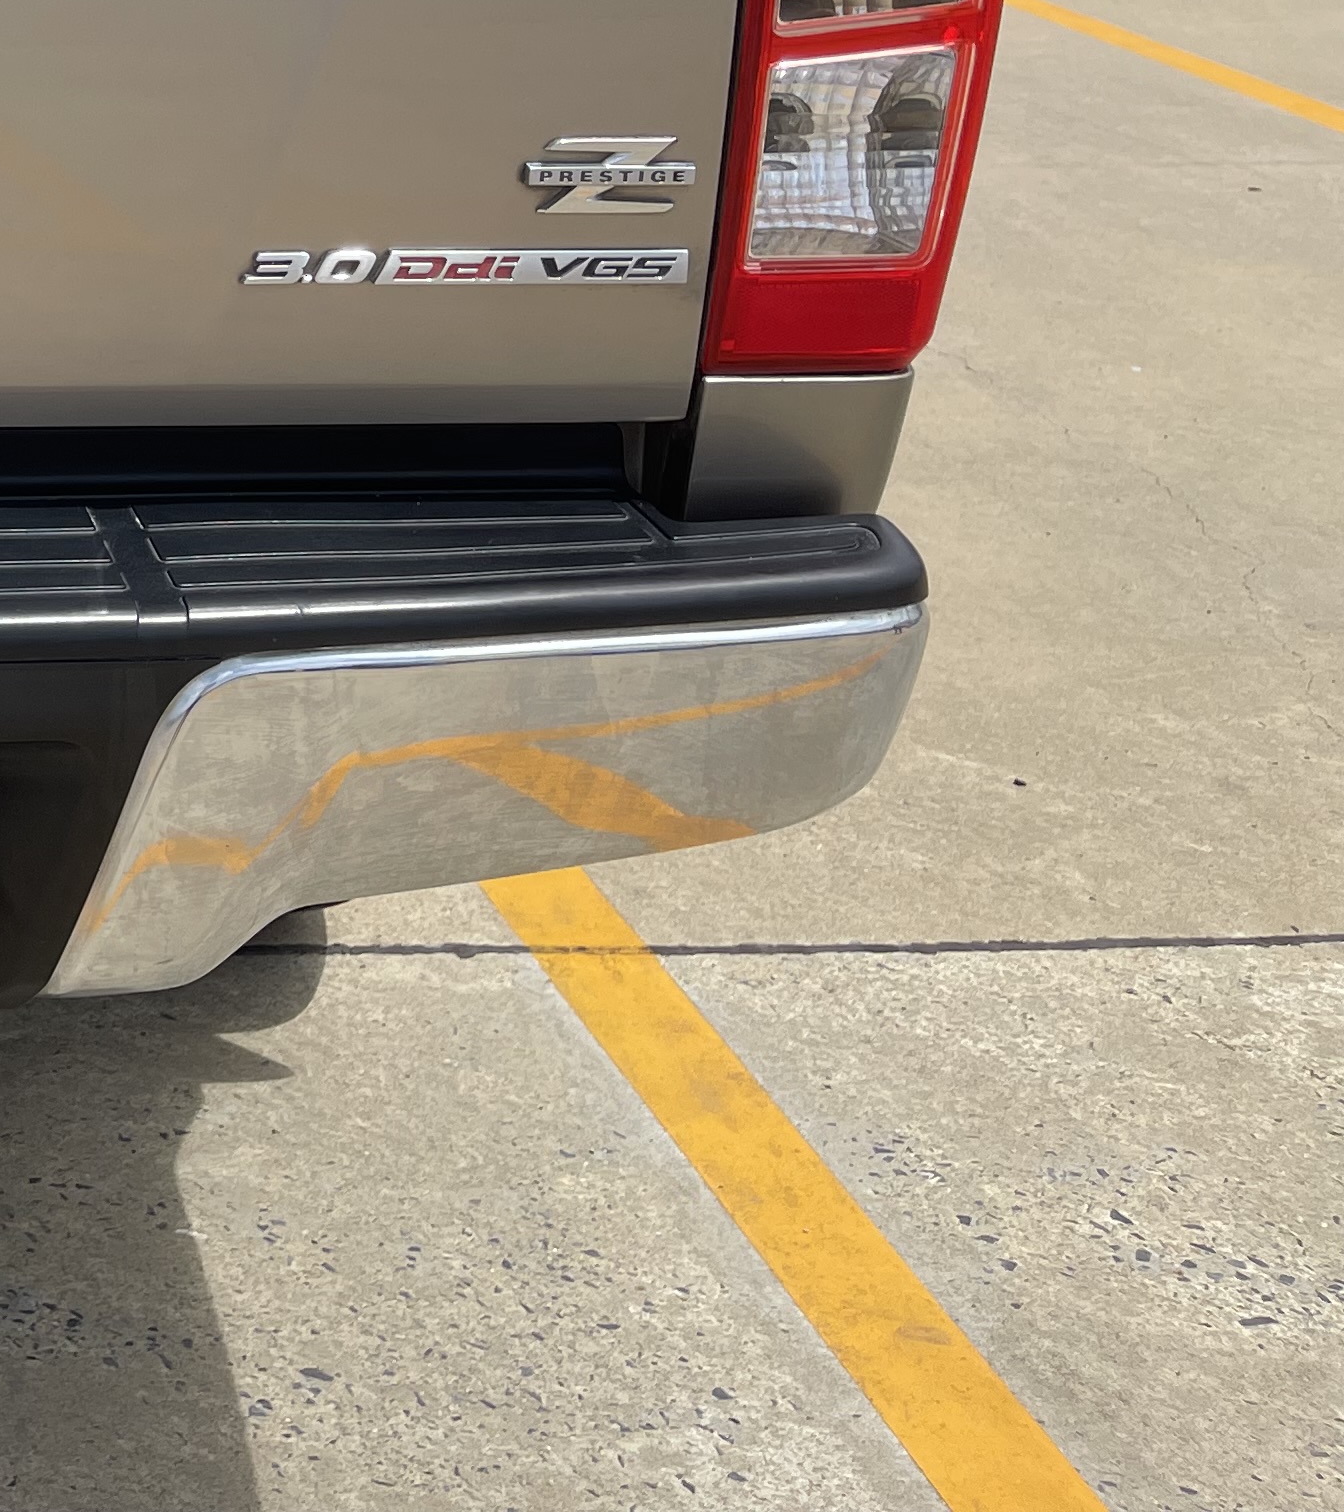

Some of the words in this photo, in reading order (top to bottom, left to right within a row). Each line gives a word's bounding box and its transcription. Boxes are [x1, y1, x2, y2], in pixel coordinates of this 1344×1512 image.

[538, 169, 686, 184] PRESTIGE
[241, 248, 377, 286] 3.0
[395, 255, 521, 282] Ddi
[540, 255, 679, 281] VGS
